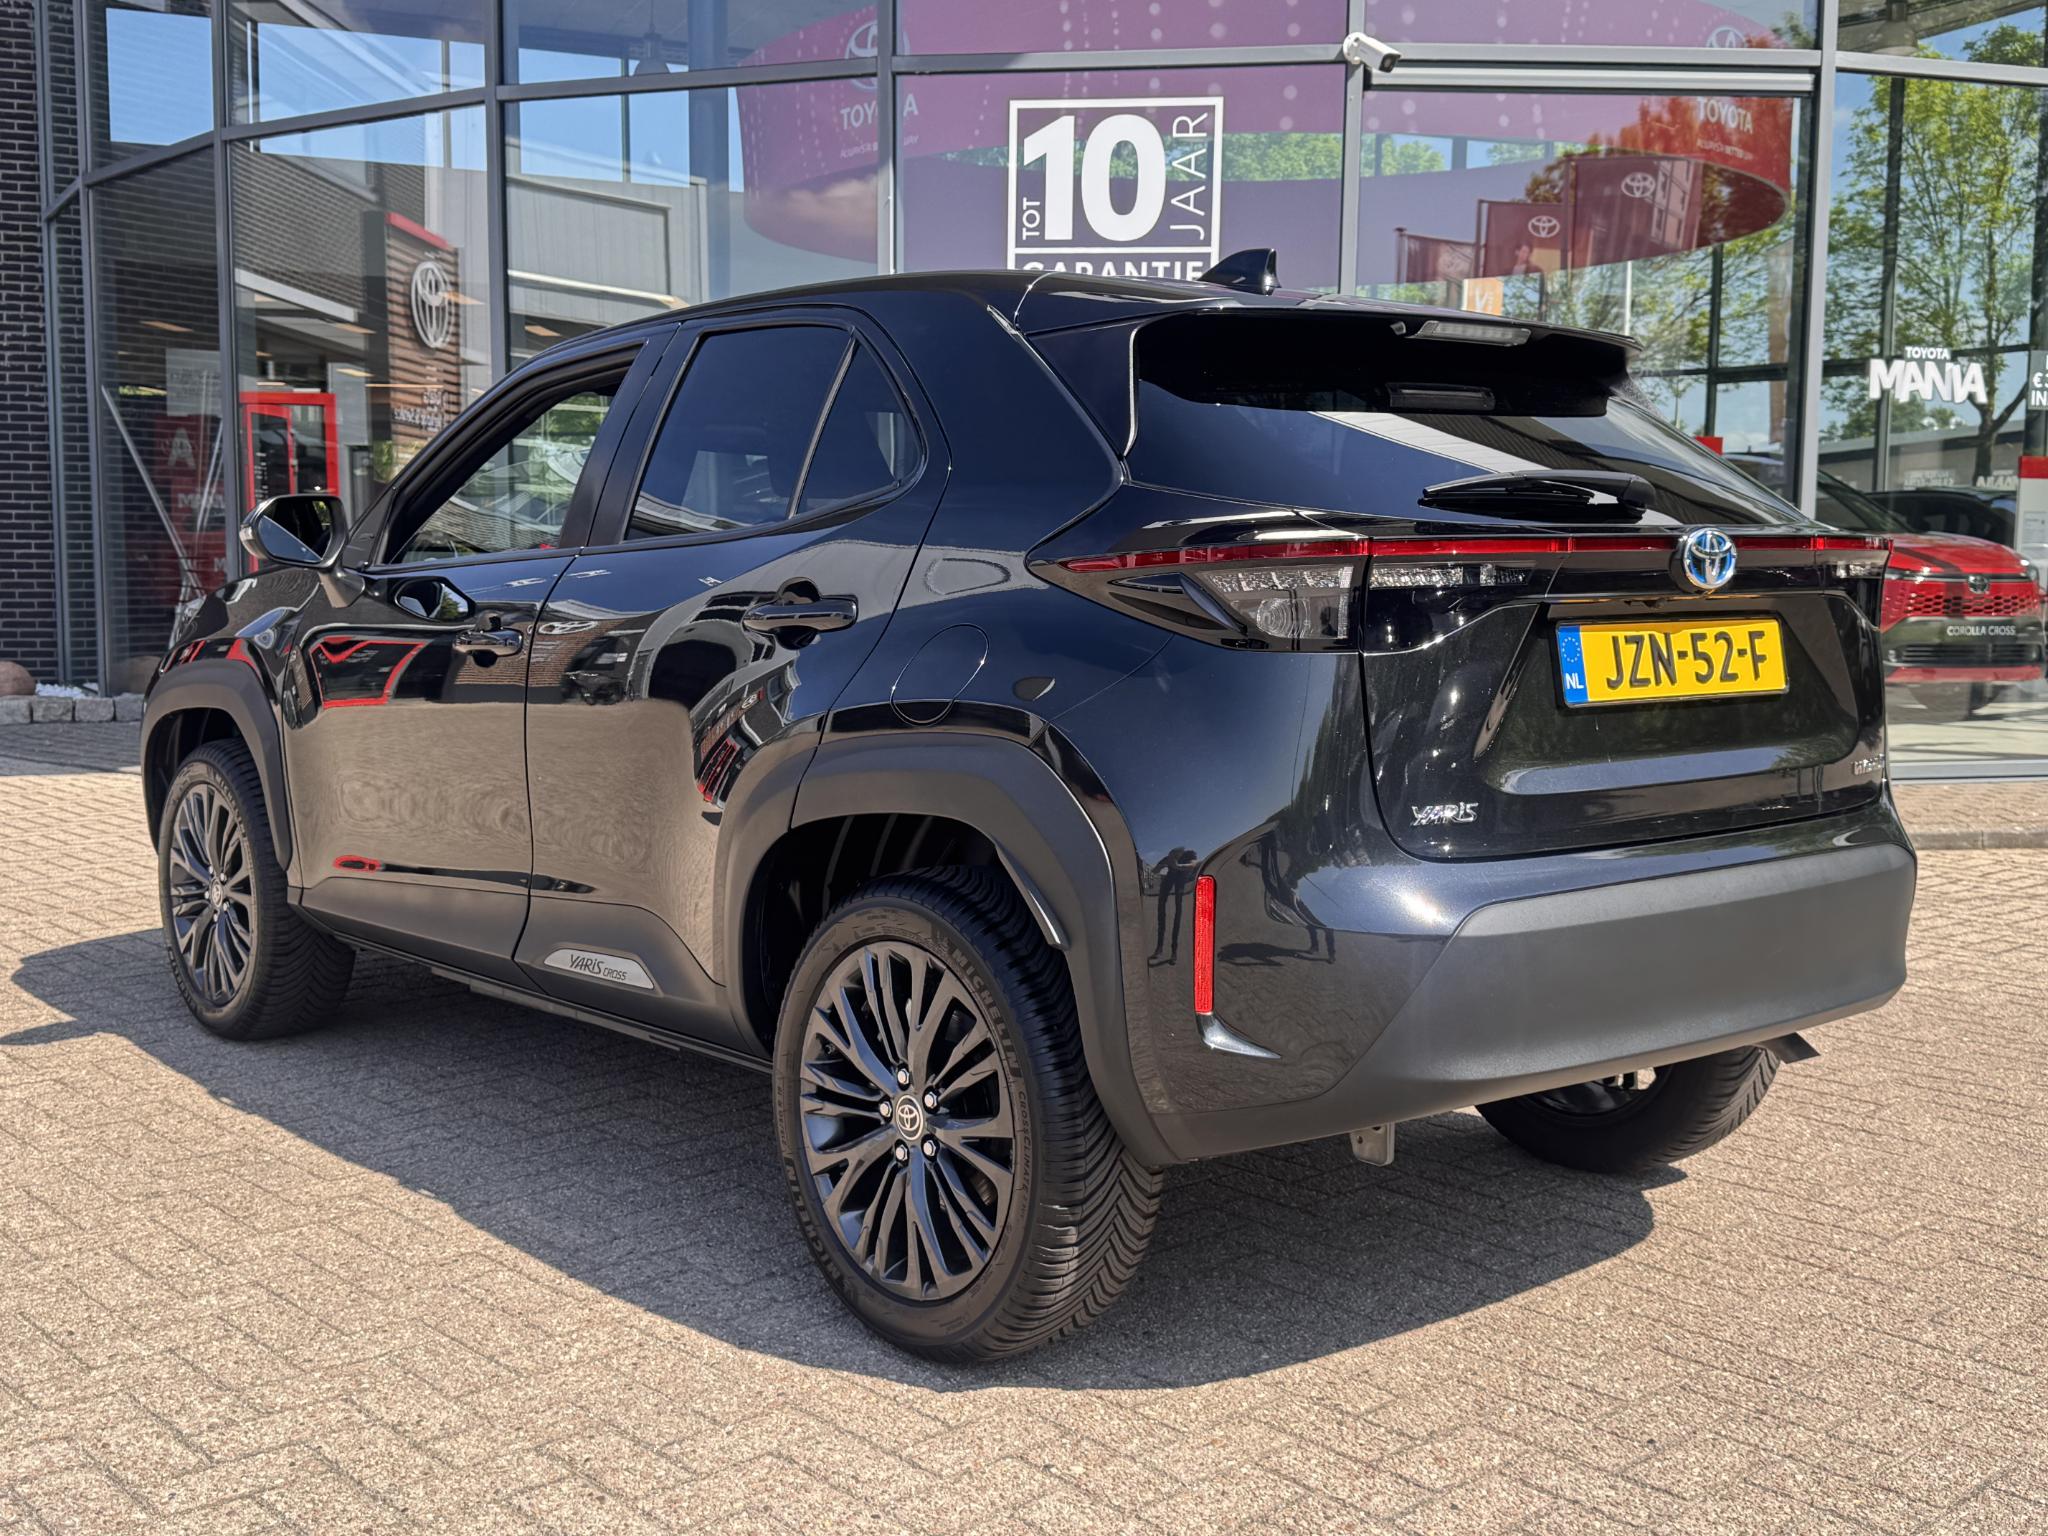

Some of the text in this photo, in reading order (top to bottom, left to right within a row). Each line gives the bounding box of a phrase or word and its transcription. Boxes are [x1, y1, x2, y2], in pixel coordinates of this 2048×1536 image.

[840, 93, 919, 130] TOYA
[1696, 96, 1754, 135] TOYOTA
[1023, 113, 1167, 242] 10
[1169, 112, 1208, 240] JAAR
[1022, 197, 1041, 241] TOT
[1904, 346, 1951, 360] TOYOTA
[1868, 358, 1988, 404] MANIA
[1946, 625, 2016, 636] COROLLA CROSS
[1565, 672, 1585, 690] NL
[1605, 630, 1768, 691] JZN-52-F
[1411, 802, 1479, 826] YARIS
[568, 954, 628, 981] YARIS CROSS
[951, 948, 1022, 1073] MICHELIN
[784, 1162, 843, 1282] MICHELIN
